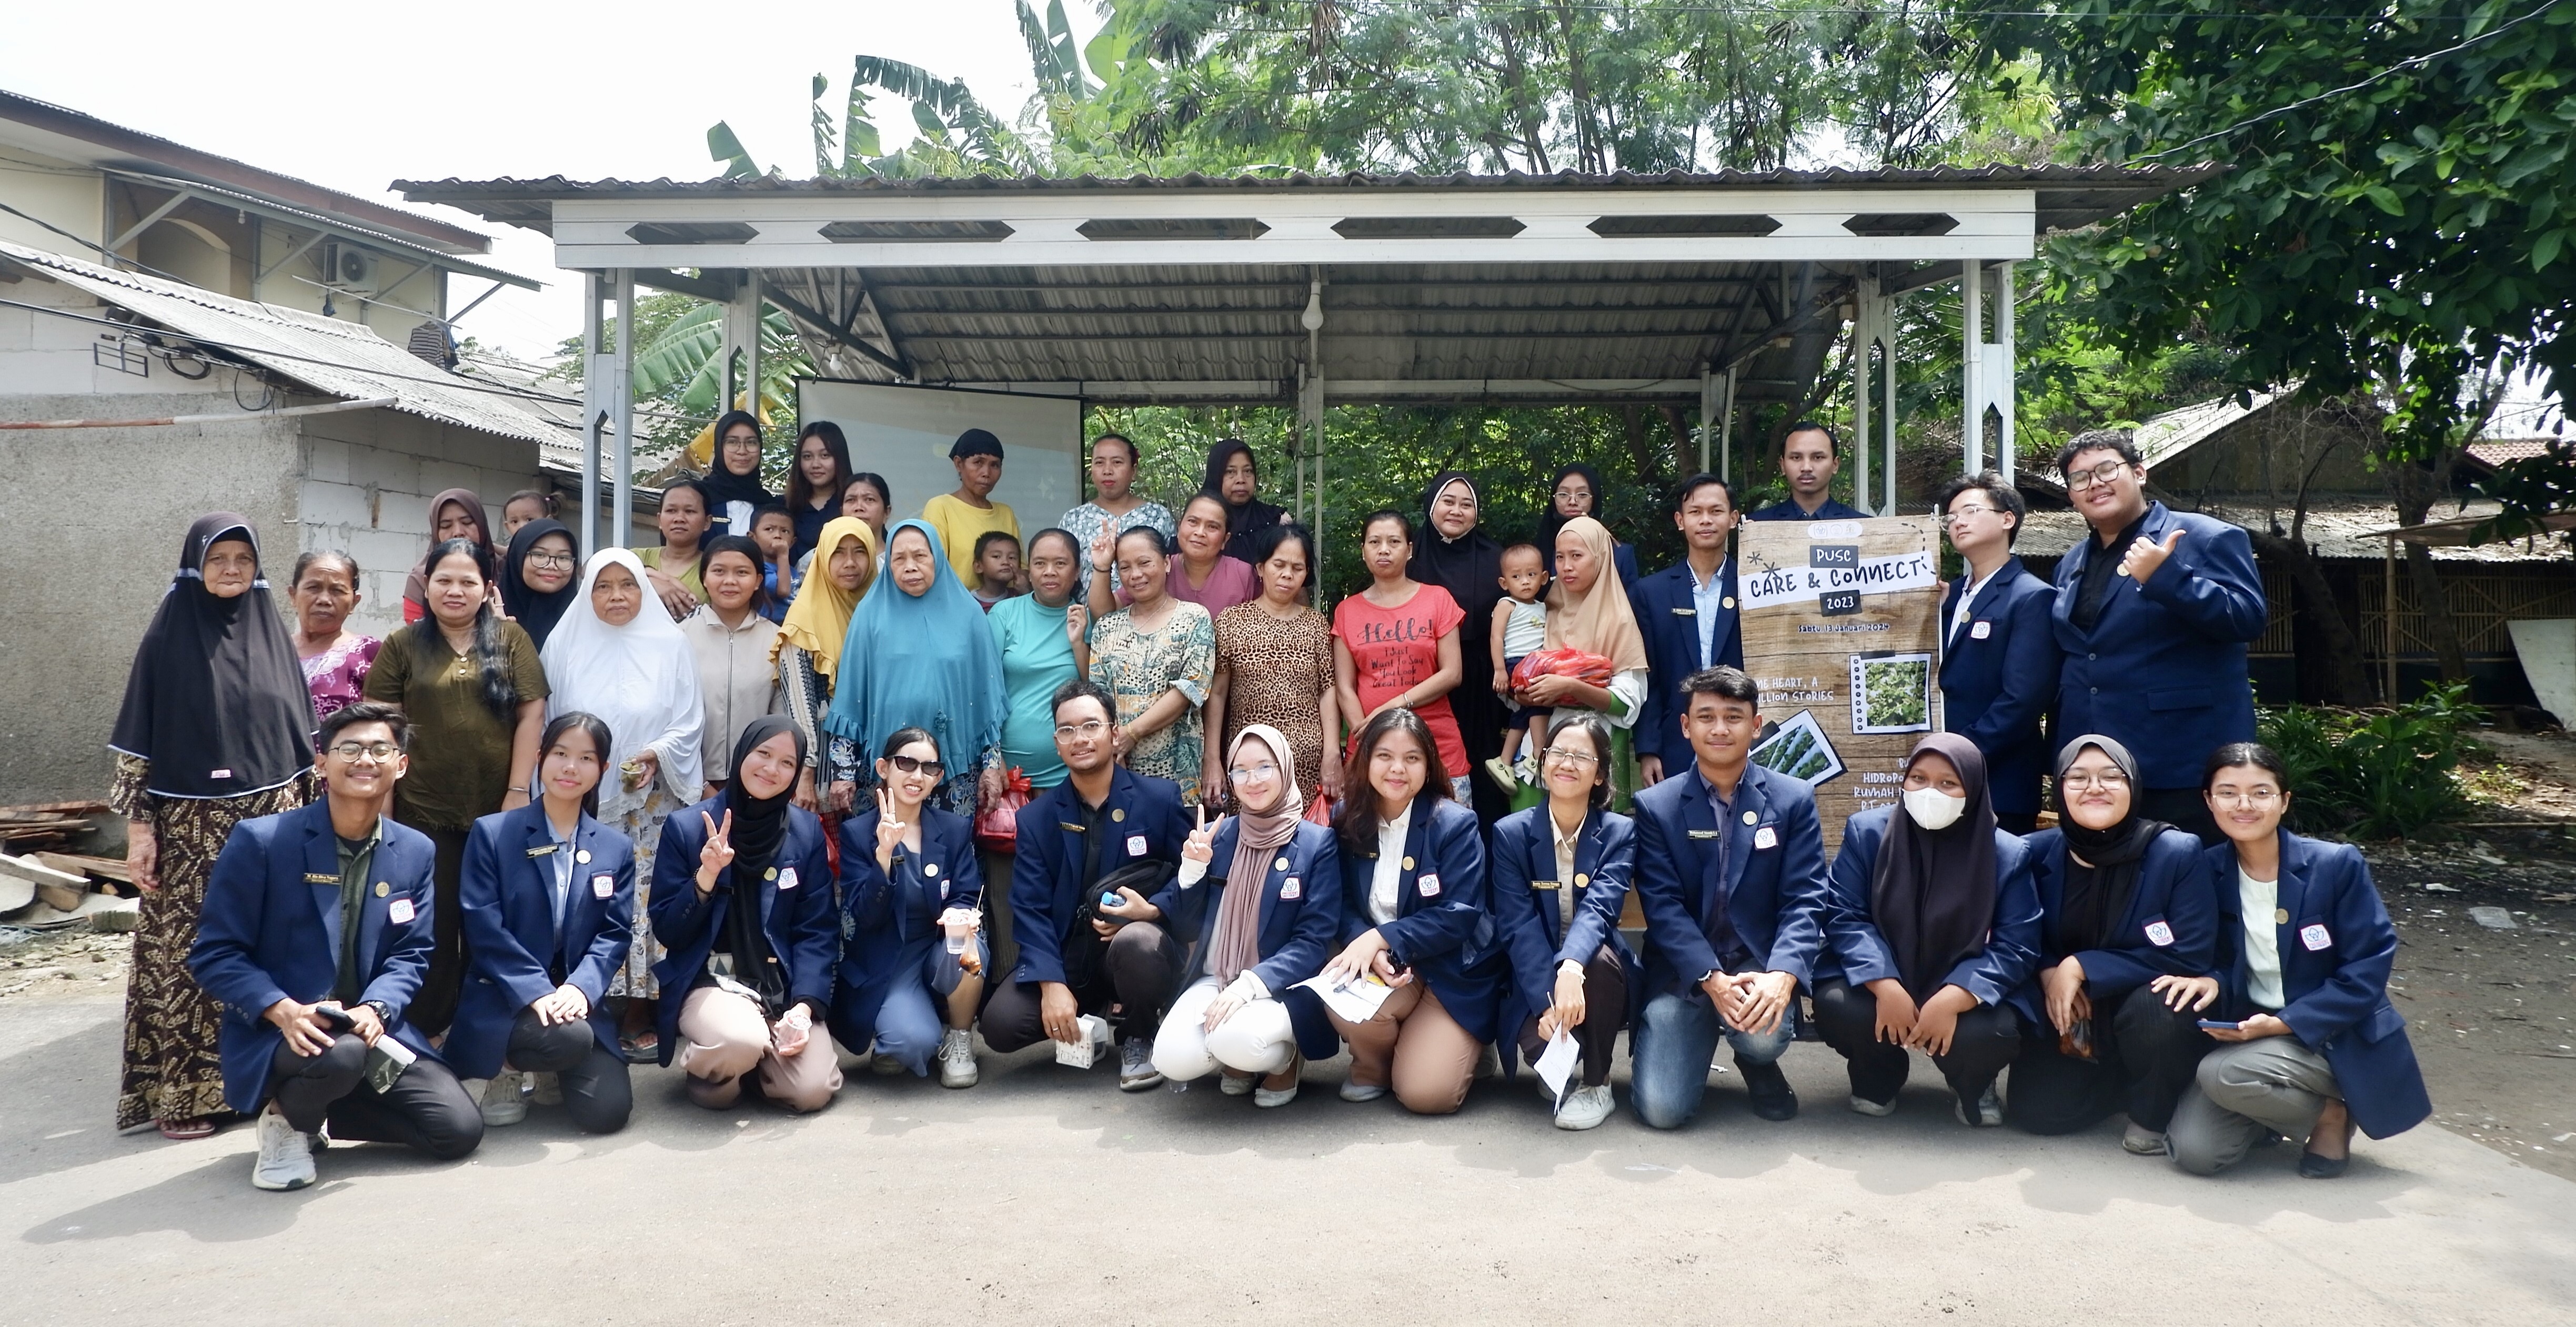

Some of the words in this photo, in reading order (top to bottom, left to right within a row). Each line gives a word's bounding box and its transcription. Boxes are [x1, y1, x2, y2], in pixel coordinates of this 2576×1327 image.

[1816, 548, 1852, 562] PUSC
[1750, 574, 1797, 597] CARE
[1808, 572, 1821, 588] &
[1830, 559, 1920, 587] CONNECT
[1826, 596, 1855, 610] 2023
[1357, 618, 1433, 644] Hello!
[1390, 646, 1408, 657] Just
[1371, 659, 1394, 670] Want
[1398, 657, 1406, 666] To
[1408, 655, 1424, 666] Say
[1379, 669, 1395, 679] You
[1397, 666, 1416, 676] Look
[1373, 679, 1396, 688] Great
[1756, 678, 1769, 689] NE
[1772, 677, 1807, 689] HEART,
[1812, 676, 1818, 687] A
[1757, 691, 1788, 703] ILLION
[1792, 690, 1834, 702] STORIES
[1863, 772, 1905, 783] HIDROPO
[1854, 786, 1894, 798] RUMAH
